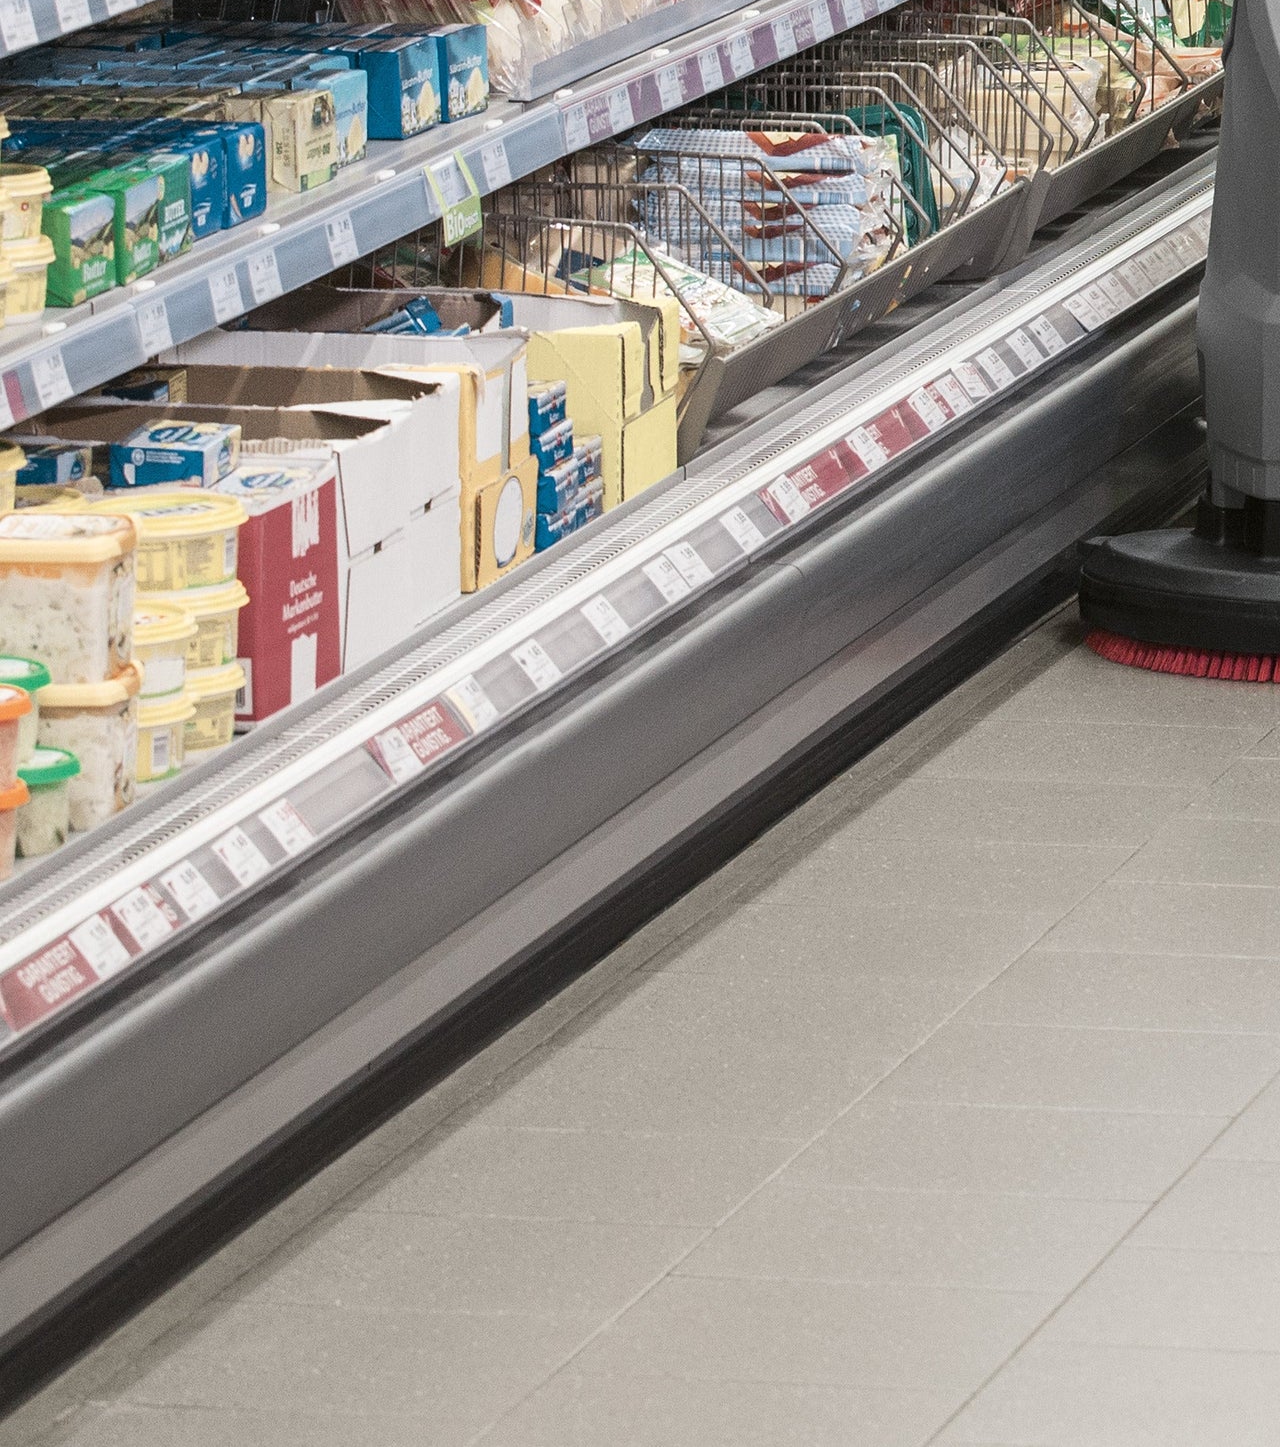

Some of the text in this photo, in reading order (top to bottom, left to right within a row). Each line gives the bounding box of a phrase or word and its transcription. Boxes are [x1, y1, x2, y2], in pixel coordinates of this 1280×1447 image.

[446, 209, 466, 241] Bio
[289, 570, 318, 599] Deutsche
[282, 590, 324, 622] Markenbutter
[16, 938, 78, 990] GARANTIERT
[38, 963, 85, 1004] GÜNSTIG
